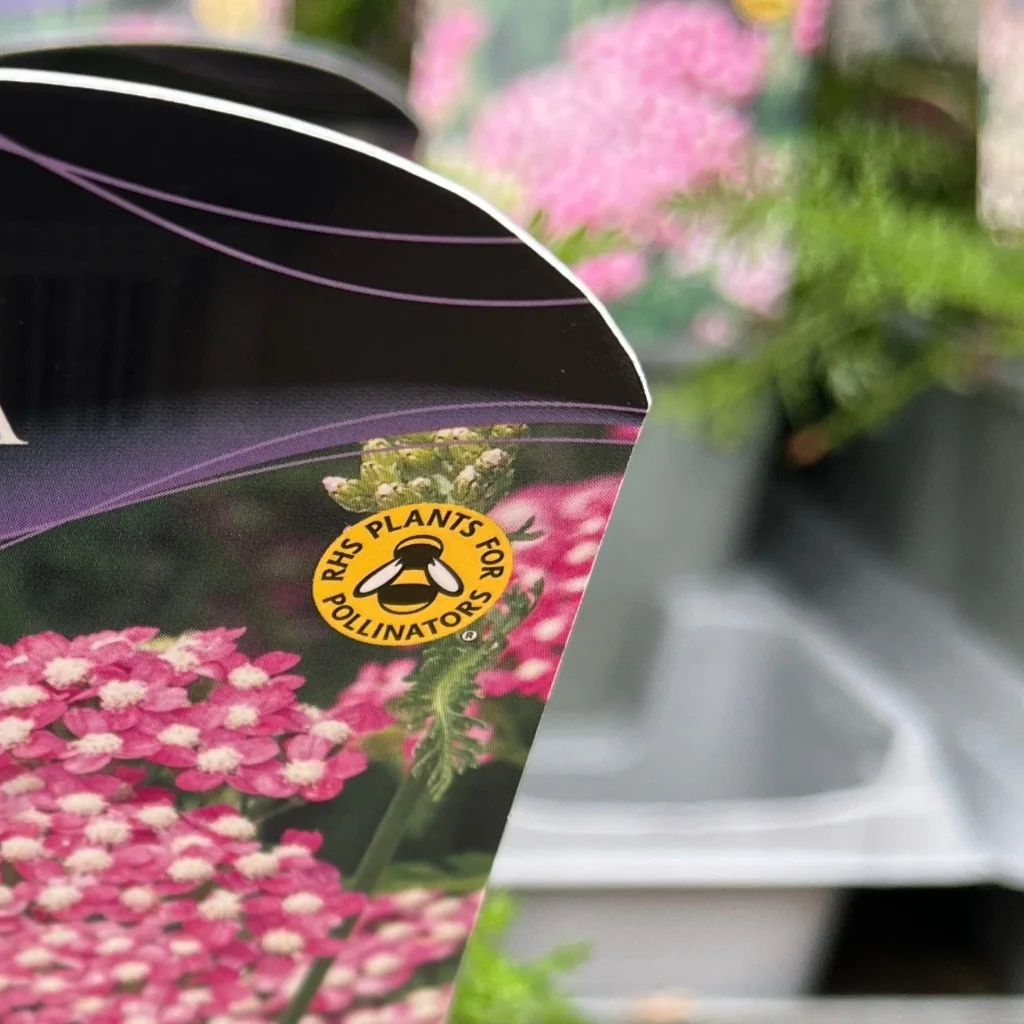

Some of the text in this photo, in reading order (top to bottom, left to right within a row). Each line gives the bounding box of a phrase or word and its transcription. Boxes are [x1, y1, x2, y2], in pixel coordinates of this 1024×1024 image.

[321, 508, 505, 582] RHS PLANTS FOR
[322, 590, 493, 641] POLLINATORS
